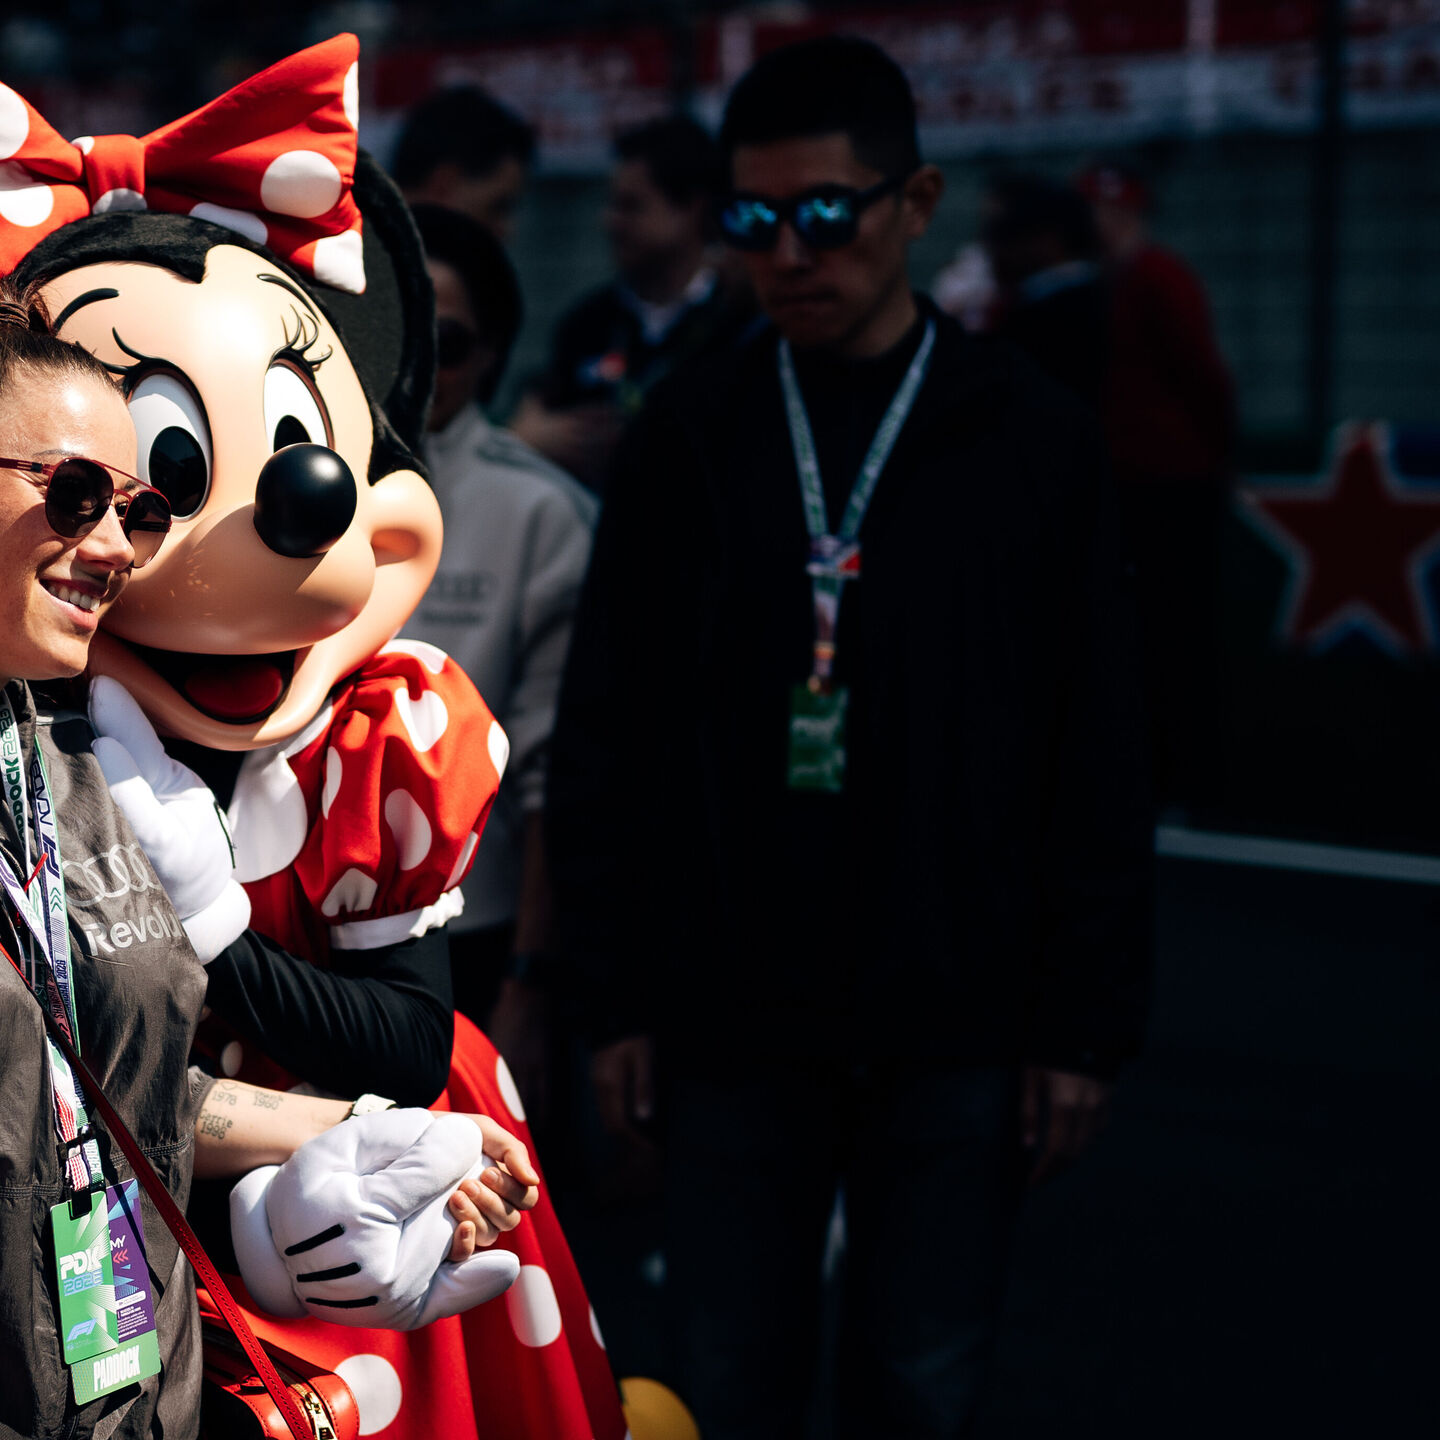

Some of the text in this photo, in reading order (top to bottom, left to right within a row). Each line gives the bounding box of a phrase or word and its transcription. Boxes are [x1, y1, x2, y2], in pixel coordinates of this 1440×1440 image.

[41, 832, 60, 879] F1
[82, 905, 187, 957] Revolu
[60, 1246, 102, 1280] PDK
[63, 1268, 103, 1296] 2026
[67, 1318, 97, 1342] F1
[93, 1344, 141, 1393] PADDOCK
